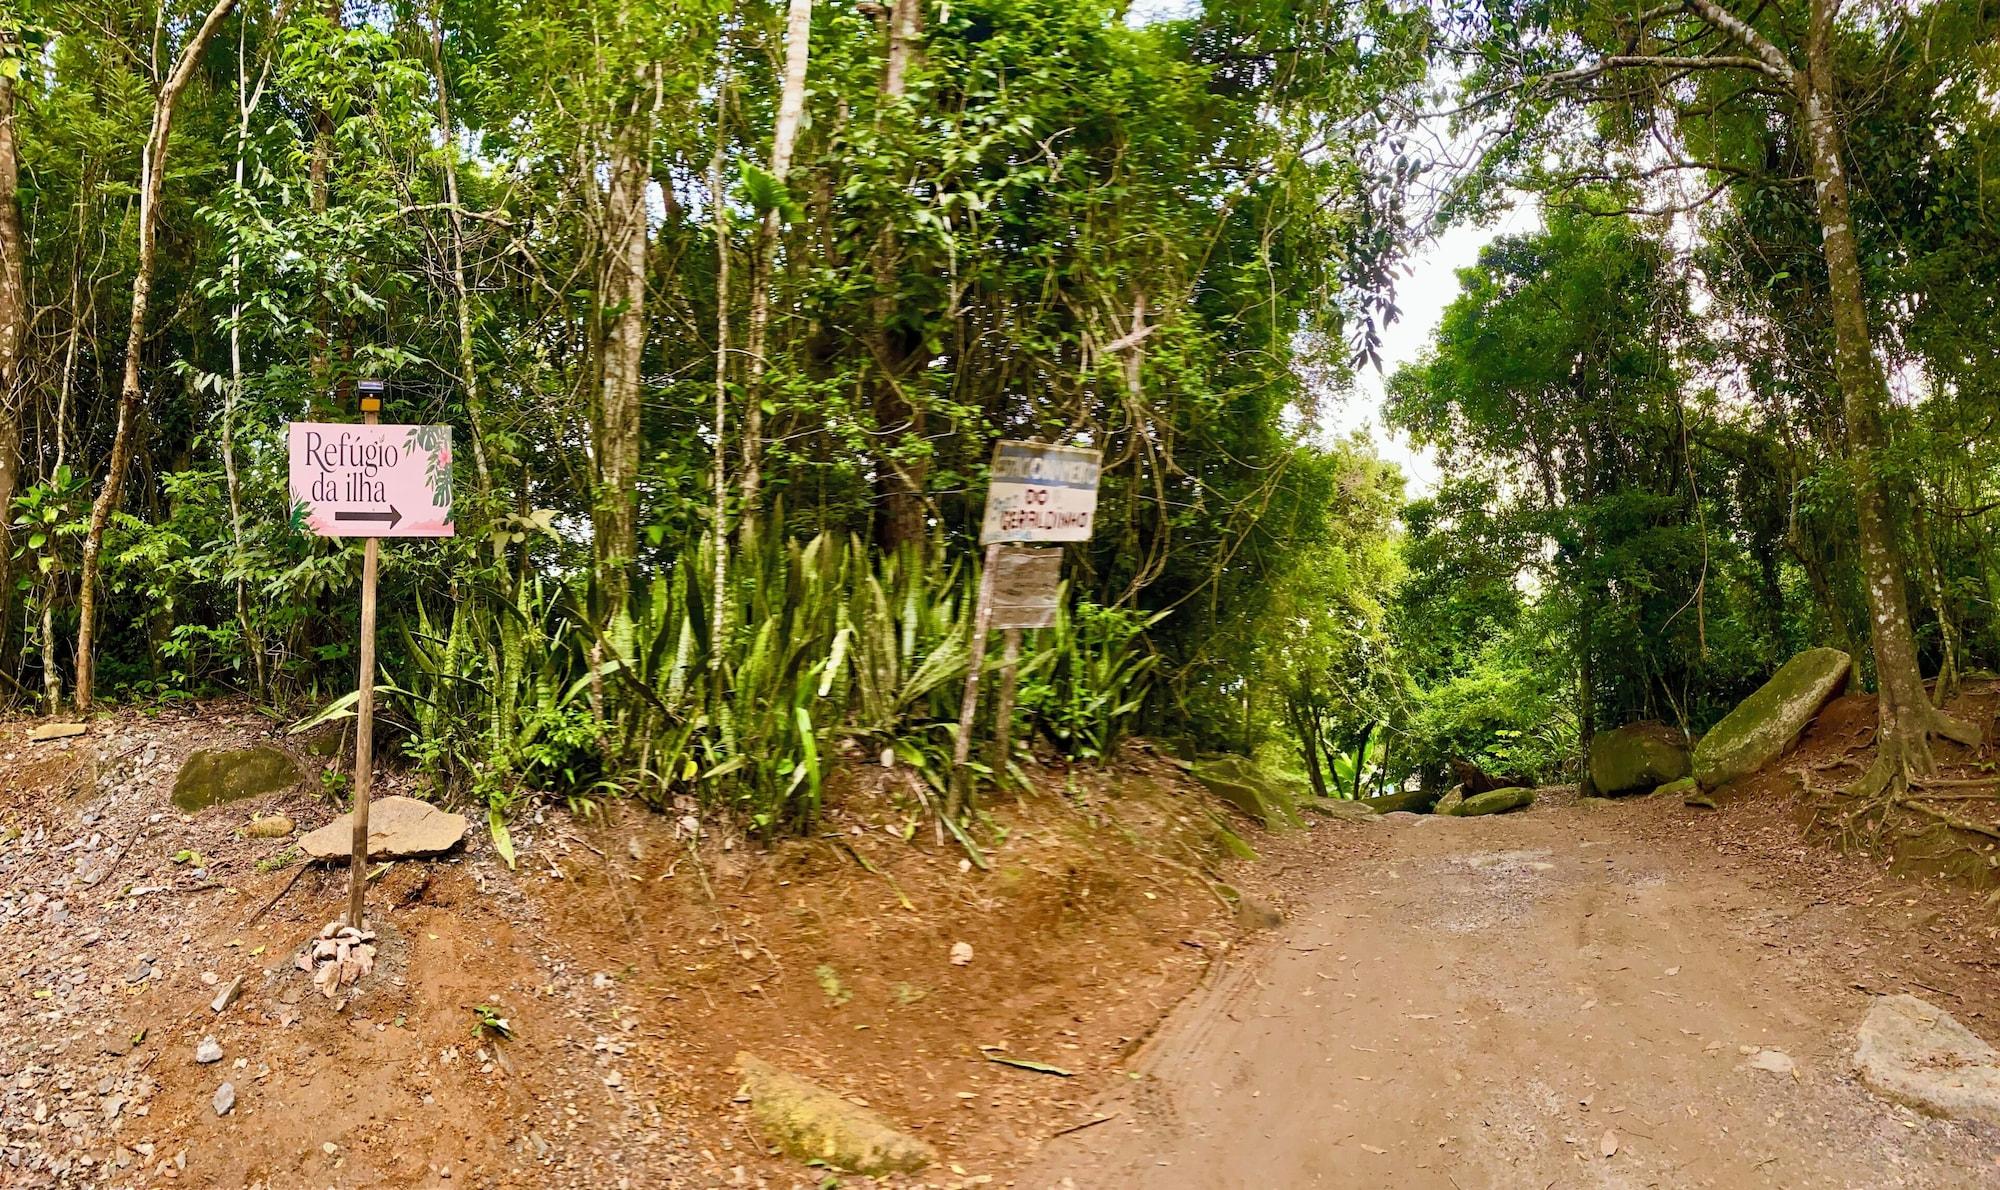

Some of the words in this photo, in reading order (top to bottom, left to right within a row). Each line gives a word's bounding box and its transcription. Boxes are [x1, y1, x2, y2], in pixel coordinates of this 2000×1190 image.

[305, 431, 398, 477] Refúgio
[312, 472, 338, 502] da
[346, 472, 386, 503] ilha
[1025, 488, 1048, 506] DO
